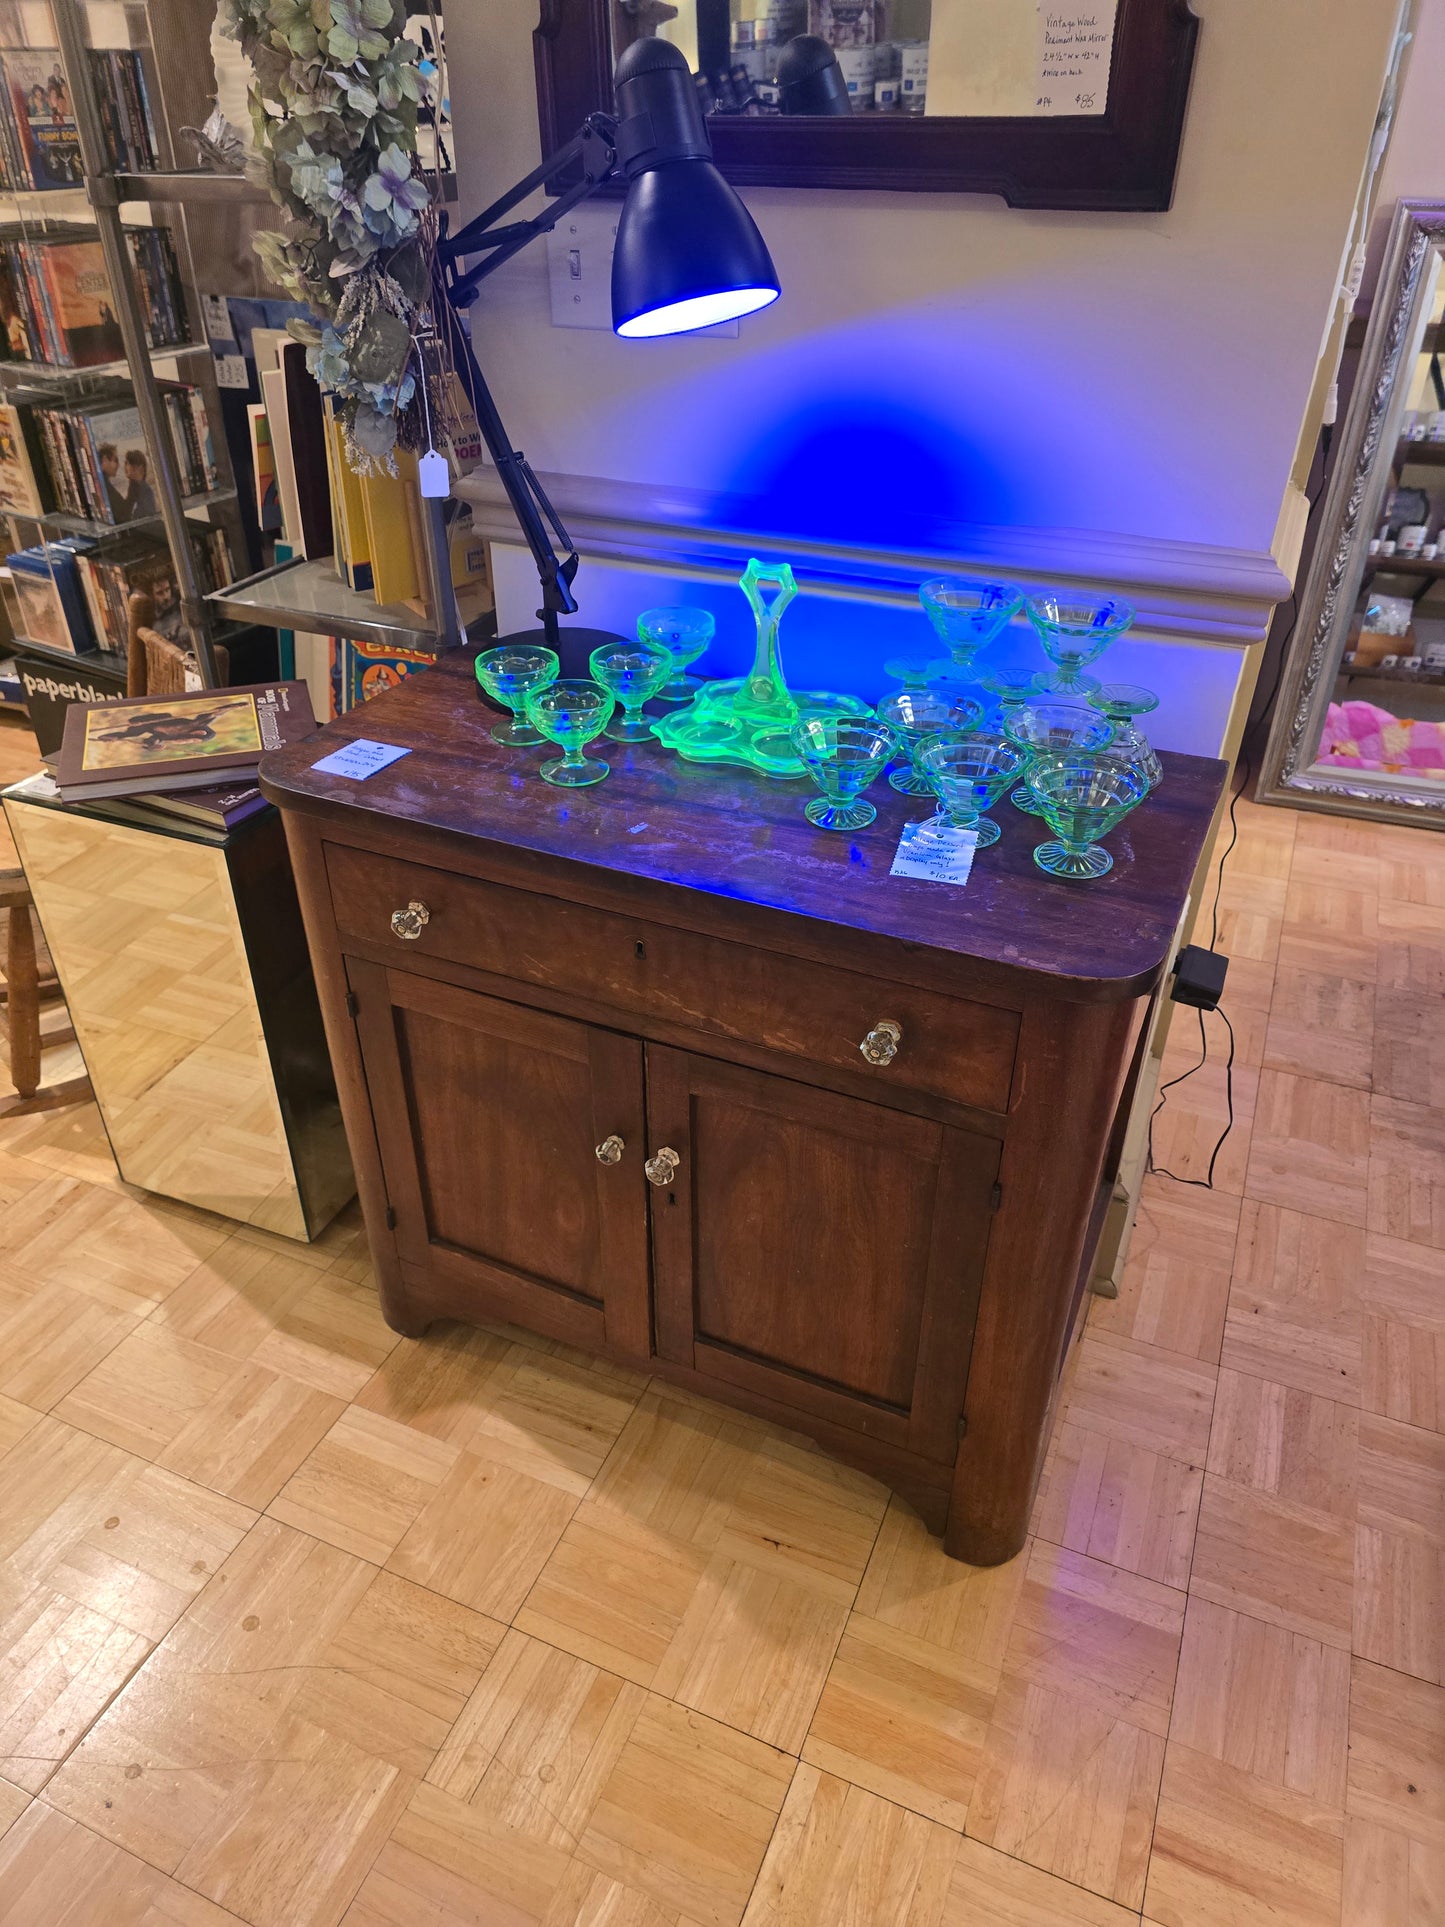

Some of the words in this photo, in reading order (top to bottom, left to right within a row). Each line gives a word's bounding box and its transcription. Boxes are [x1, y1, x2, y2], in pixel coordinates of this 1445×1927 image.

[1046, 13, 1075, 33] Vintage
[1077, 14, 1098, 27] Wood
[1088, 33, 1108, 43] Mirror
[459, 436, 467, 445] to
[257, 703, 287, 751] Mammals
[905, 856, 928, 865] Display
